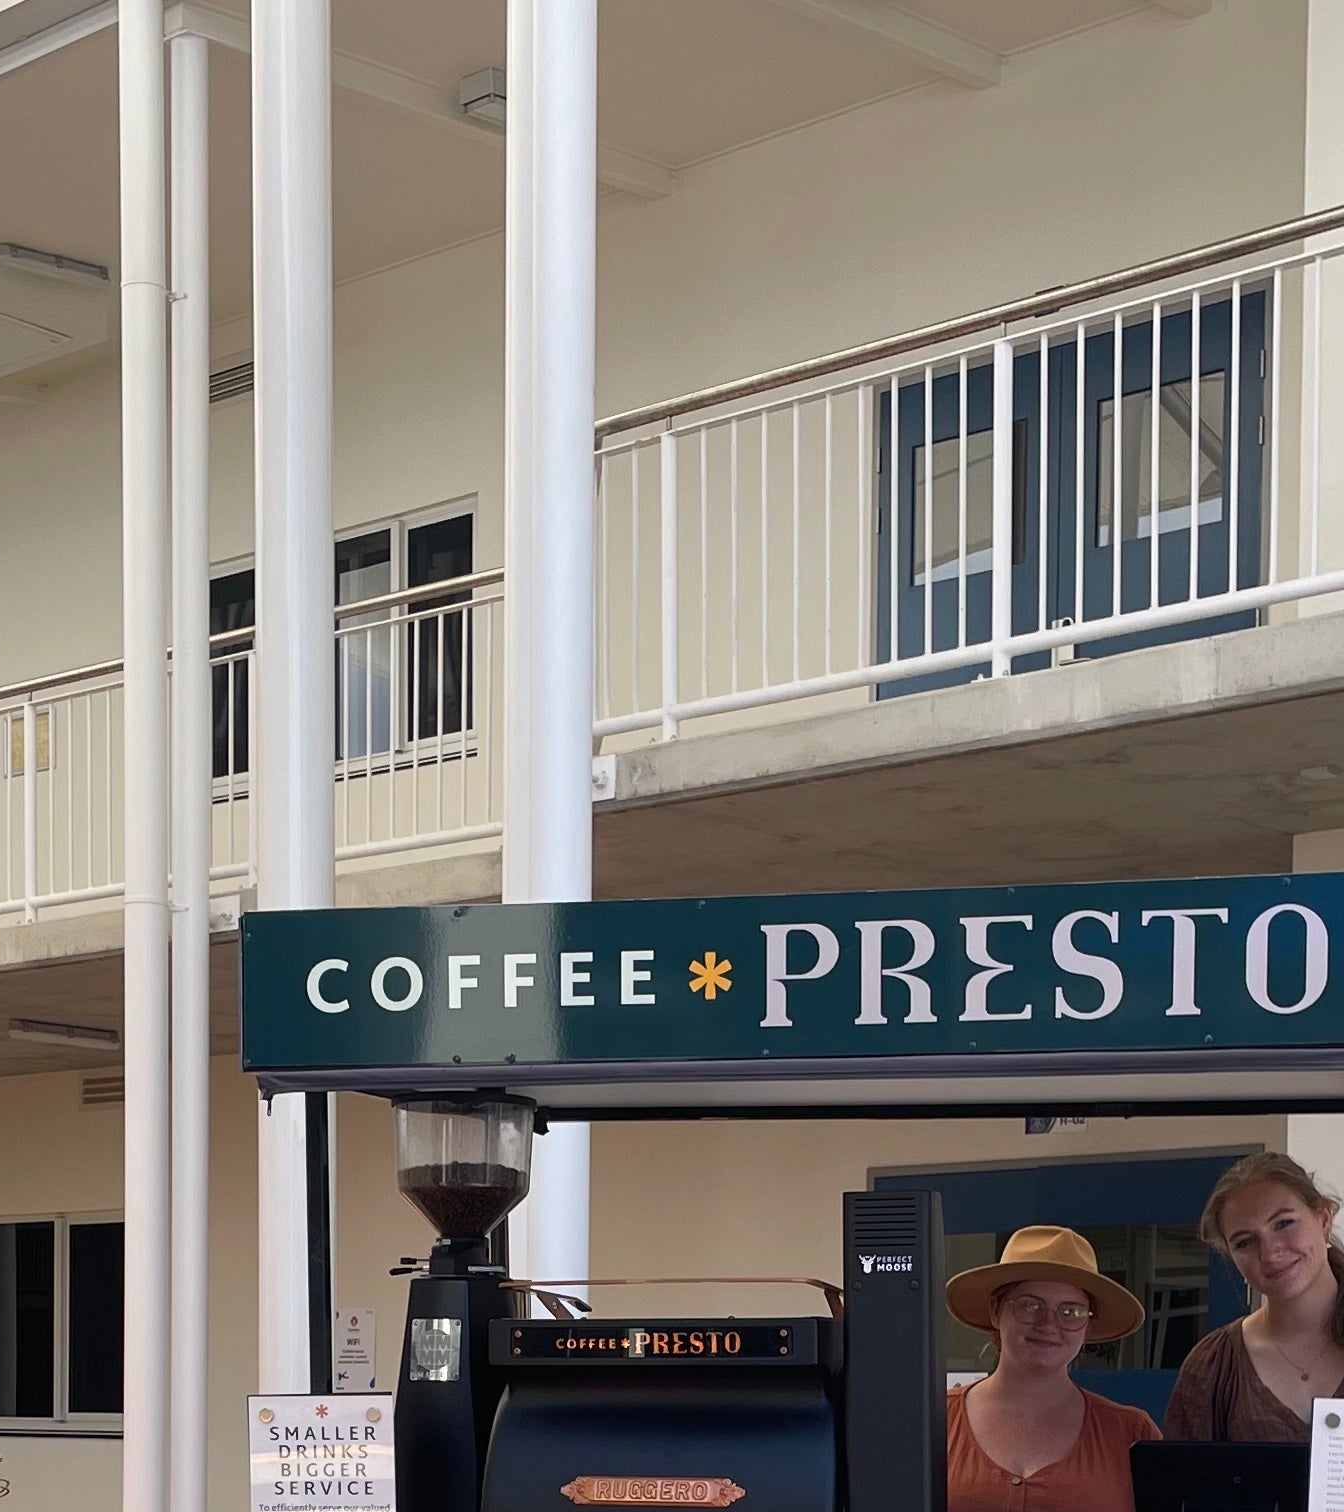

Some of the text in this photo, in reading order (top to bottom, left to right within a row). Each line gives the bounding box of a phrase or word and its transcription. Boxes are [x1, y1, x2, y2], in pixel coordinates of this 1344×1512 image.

[306, 903, 1331, 1028] COFFEE PRESTO
[877, 1264, 913, 1272] MOOSE
[556, 1331, 742, 1355] COFFEE PRESTO
[269, 1426, 377, 1441] SMALLER
[278, 1444, 368, 1459] DRINKS
[281, 1463, 367, 1477] BIGGER
[274, 1481, 375, 1495] SERVICE
[596, 1479, 708, 1501] RUGGERO
[259, 1504, 270, 1512] To
